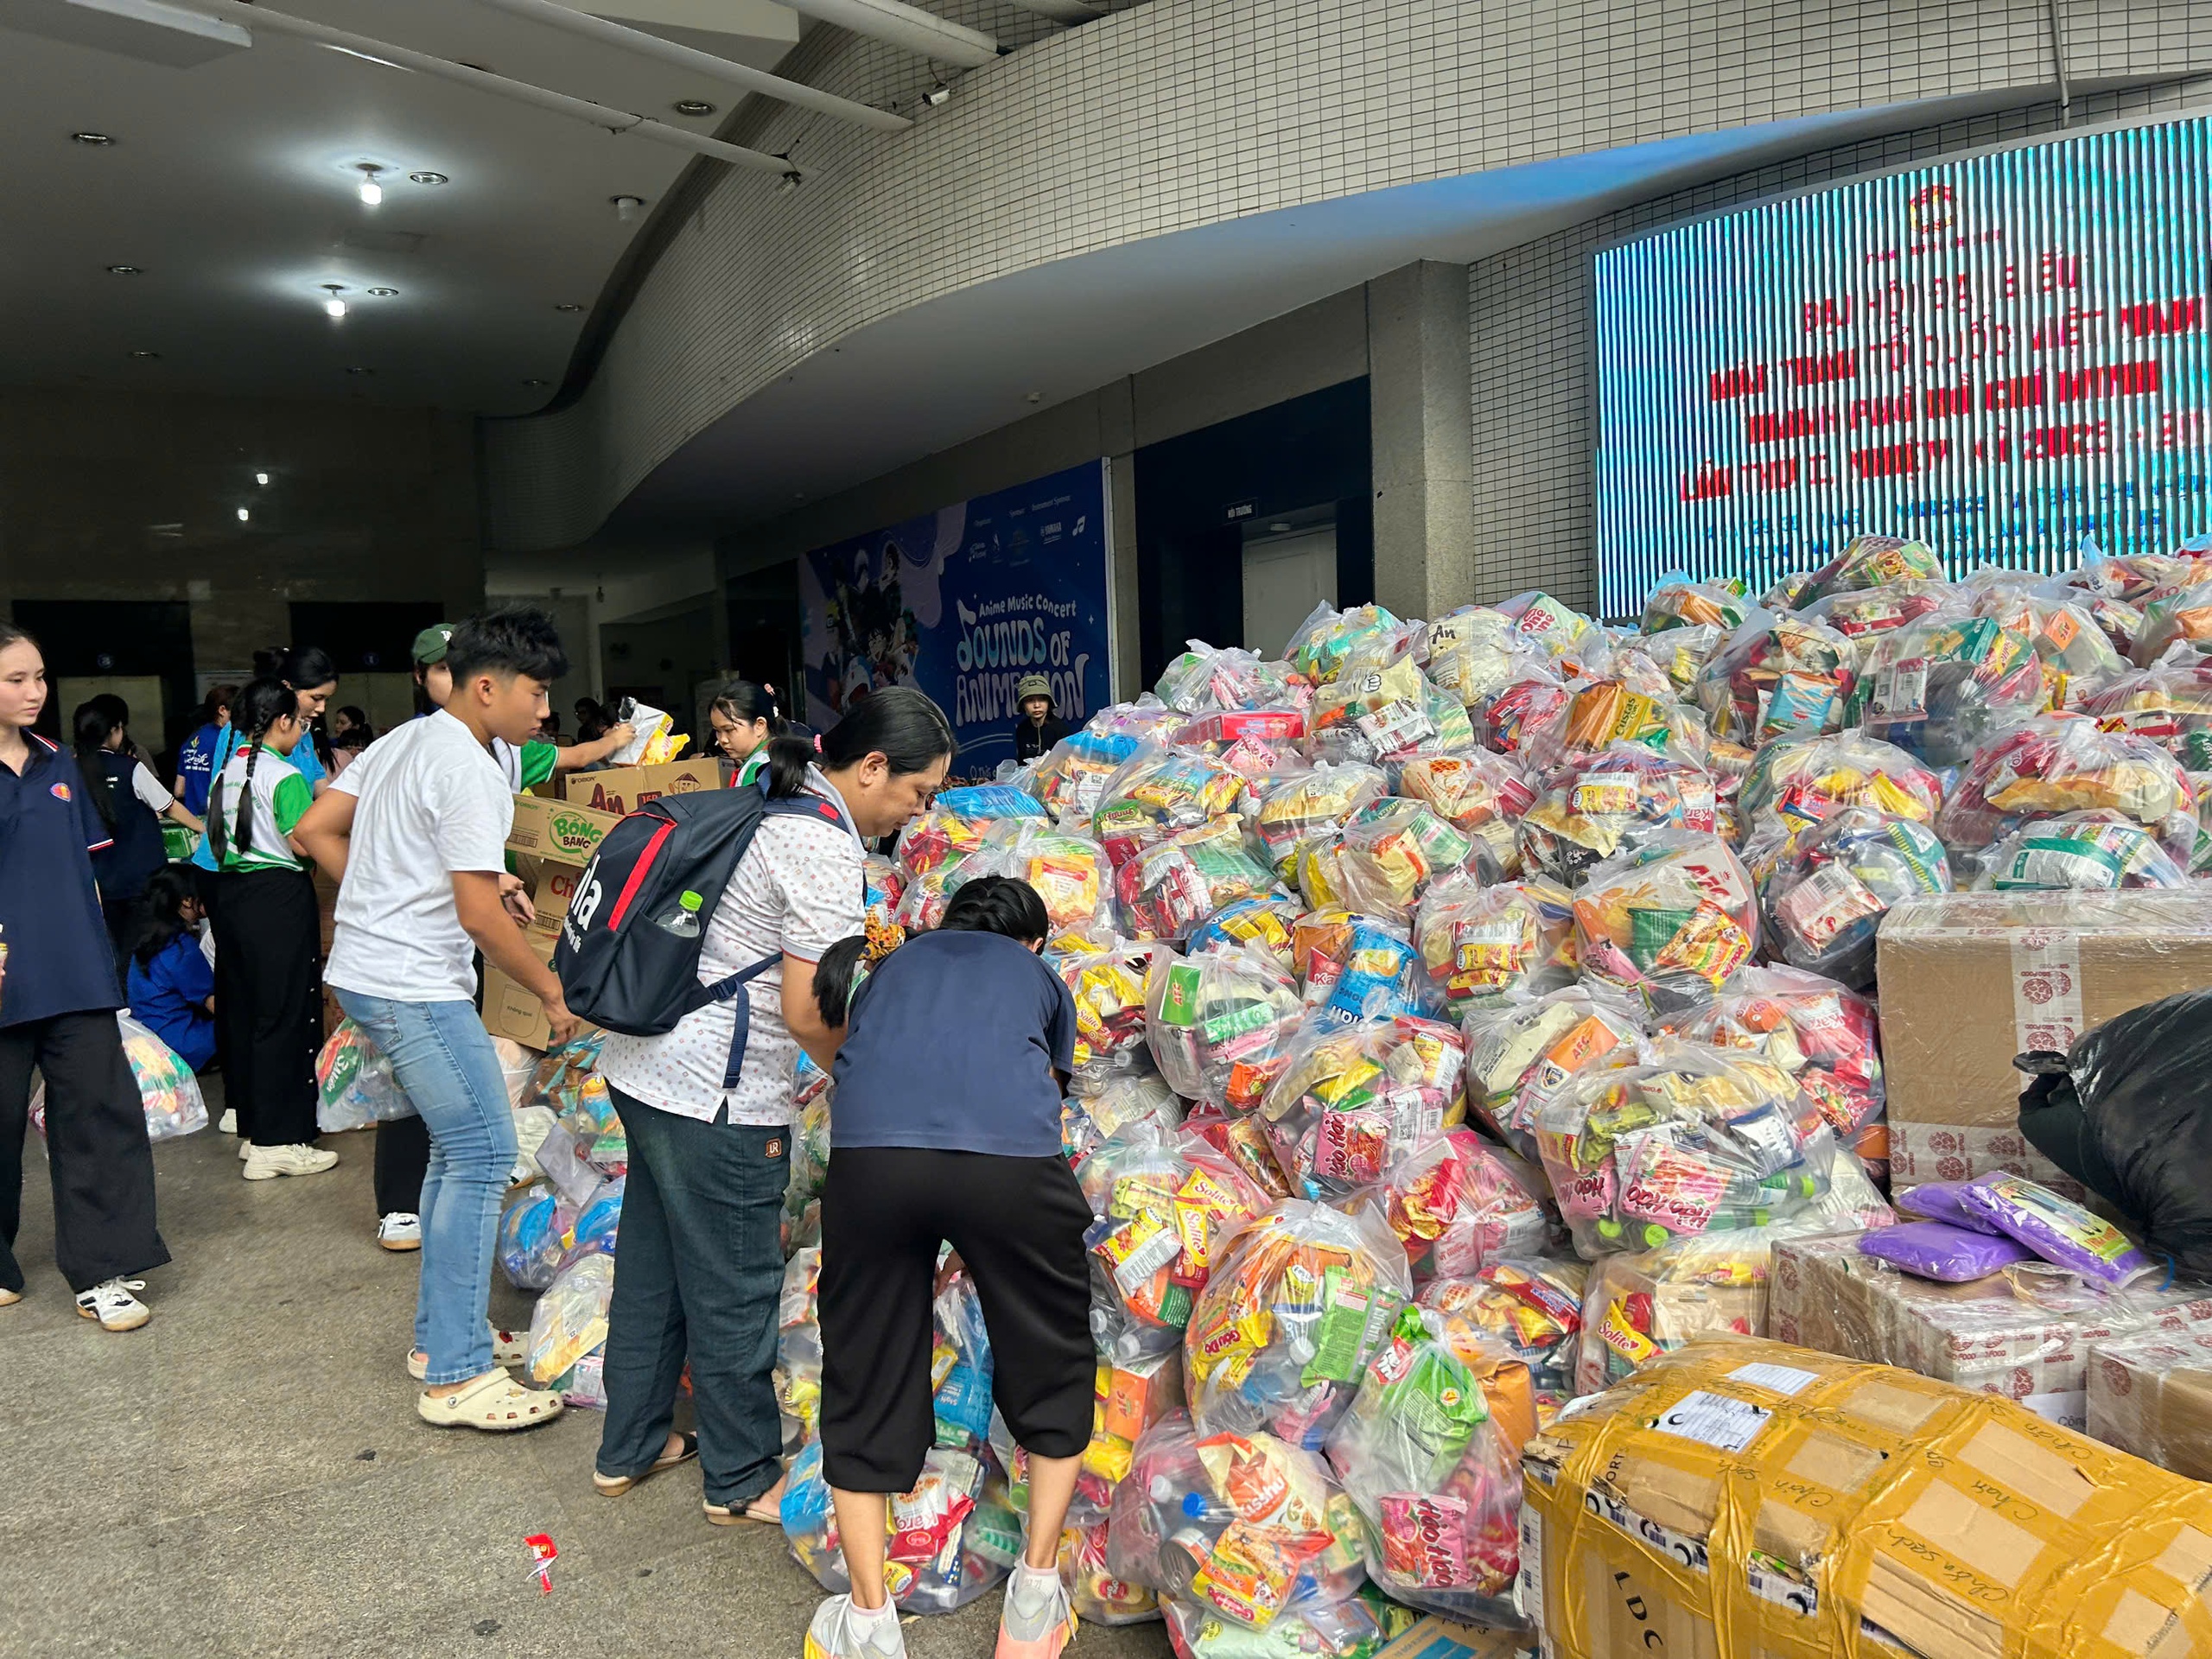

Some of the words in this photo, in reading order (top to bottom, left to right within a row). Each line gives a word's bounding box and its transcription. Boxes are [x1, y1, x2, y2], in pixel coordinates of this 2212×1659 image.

[979, 601, 1006, 618] Anime
[1007, 594, 1033, 613] Music
[1036, 594, 1077, 618] Concert
[1430, 624, 1457, 645] An
[1050, 631, 1071, 667] OF
[1615, 696, 1637, 736] Custas
[563, 836, 592, 849] BANG
[550, 874, 575, 899] Ch
[1194, 1180, 1231, 1205] Solite
[1185, 1210, 1203, 1250] Solite
[1599, 1320, 1630, 1350] Solite
